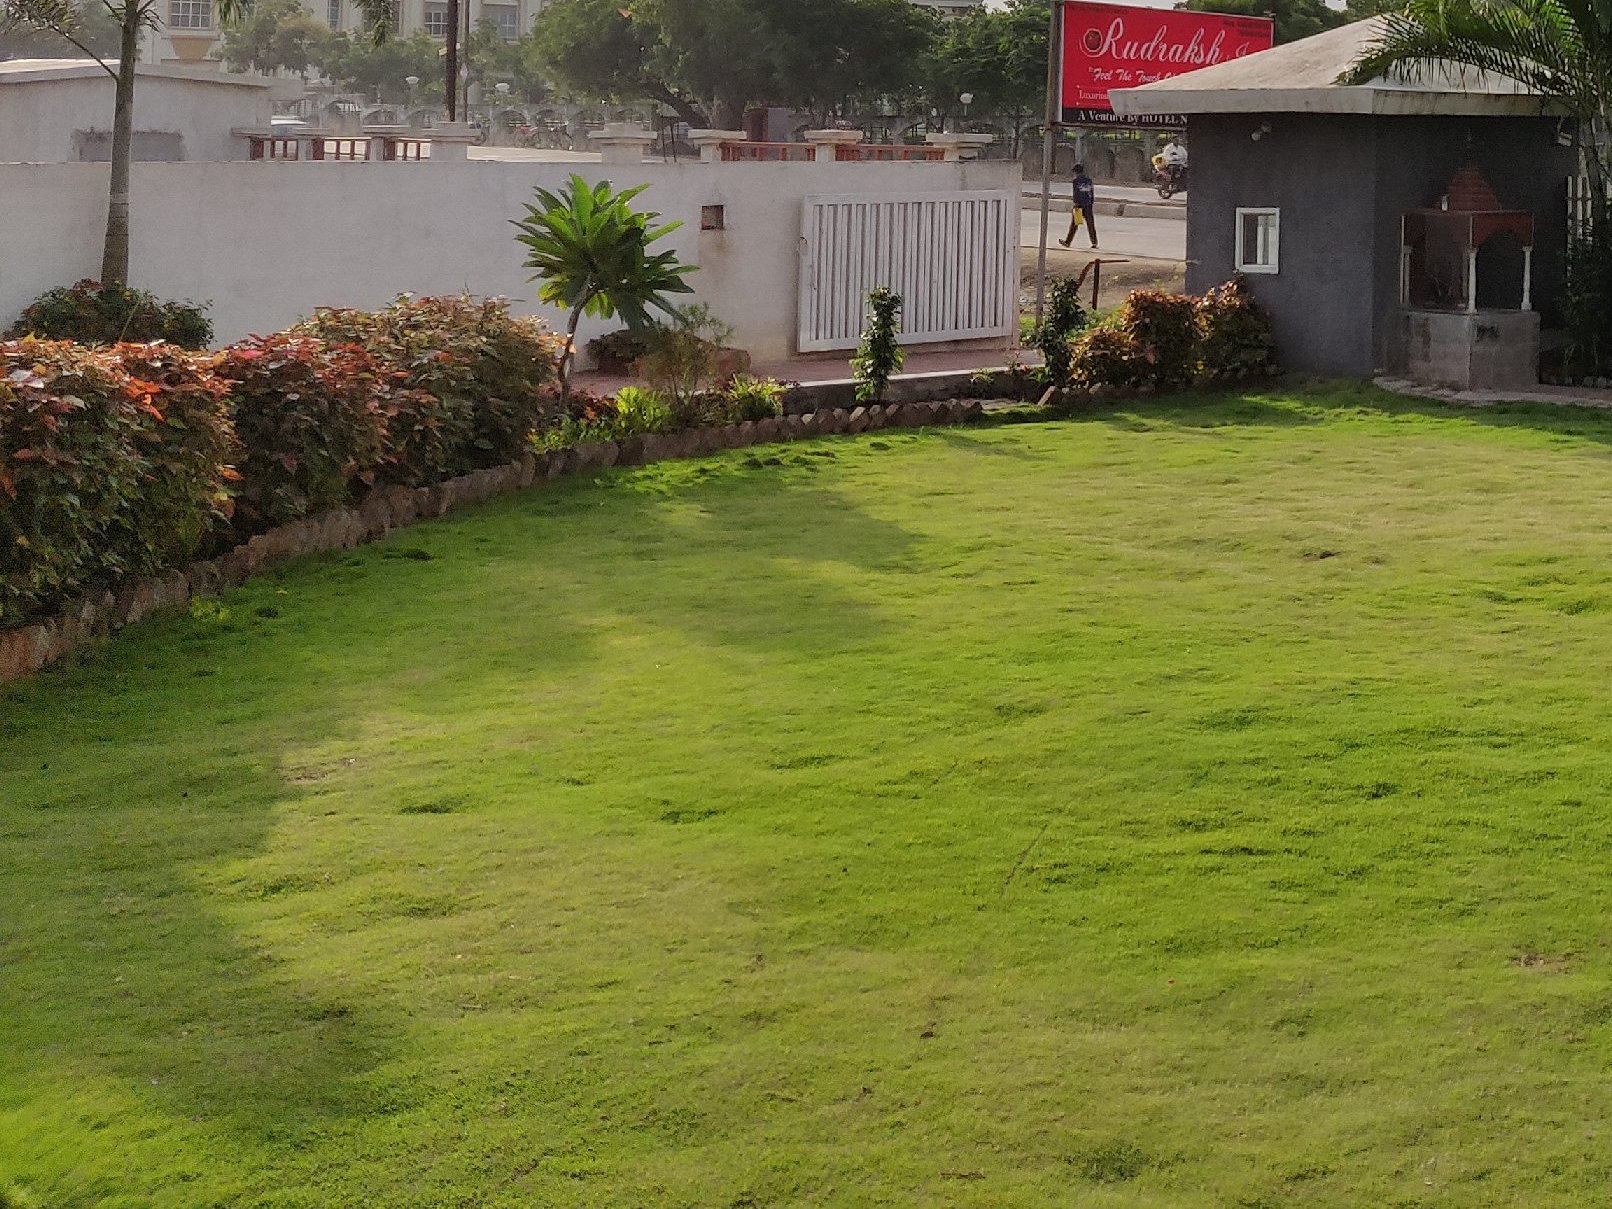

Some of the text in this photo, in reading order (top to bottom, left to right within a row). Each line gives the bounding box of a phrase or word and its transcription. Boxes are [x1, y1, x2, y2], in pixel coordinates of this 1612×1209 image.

[1098, 17, 1226, 65] Rudraksh
[1115, 68, 1133, 81] The
[1077, 110, 1086, 121] A
